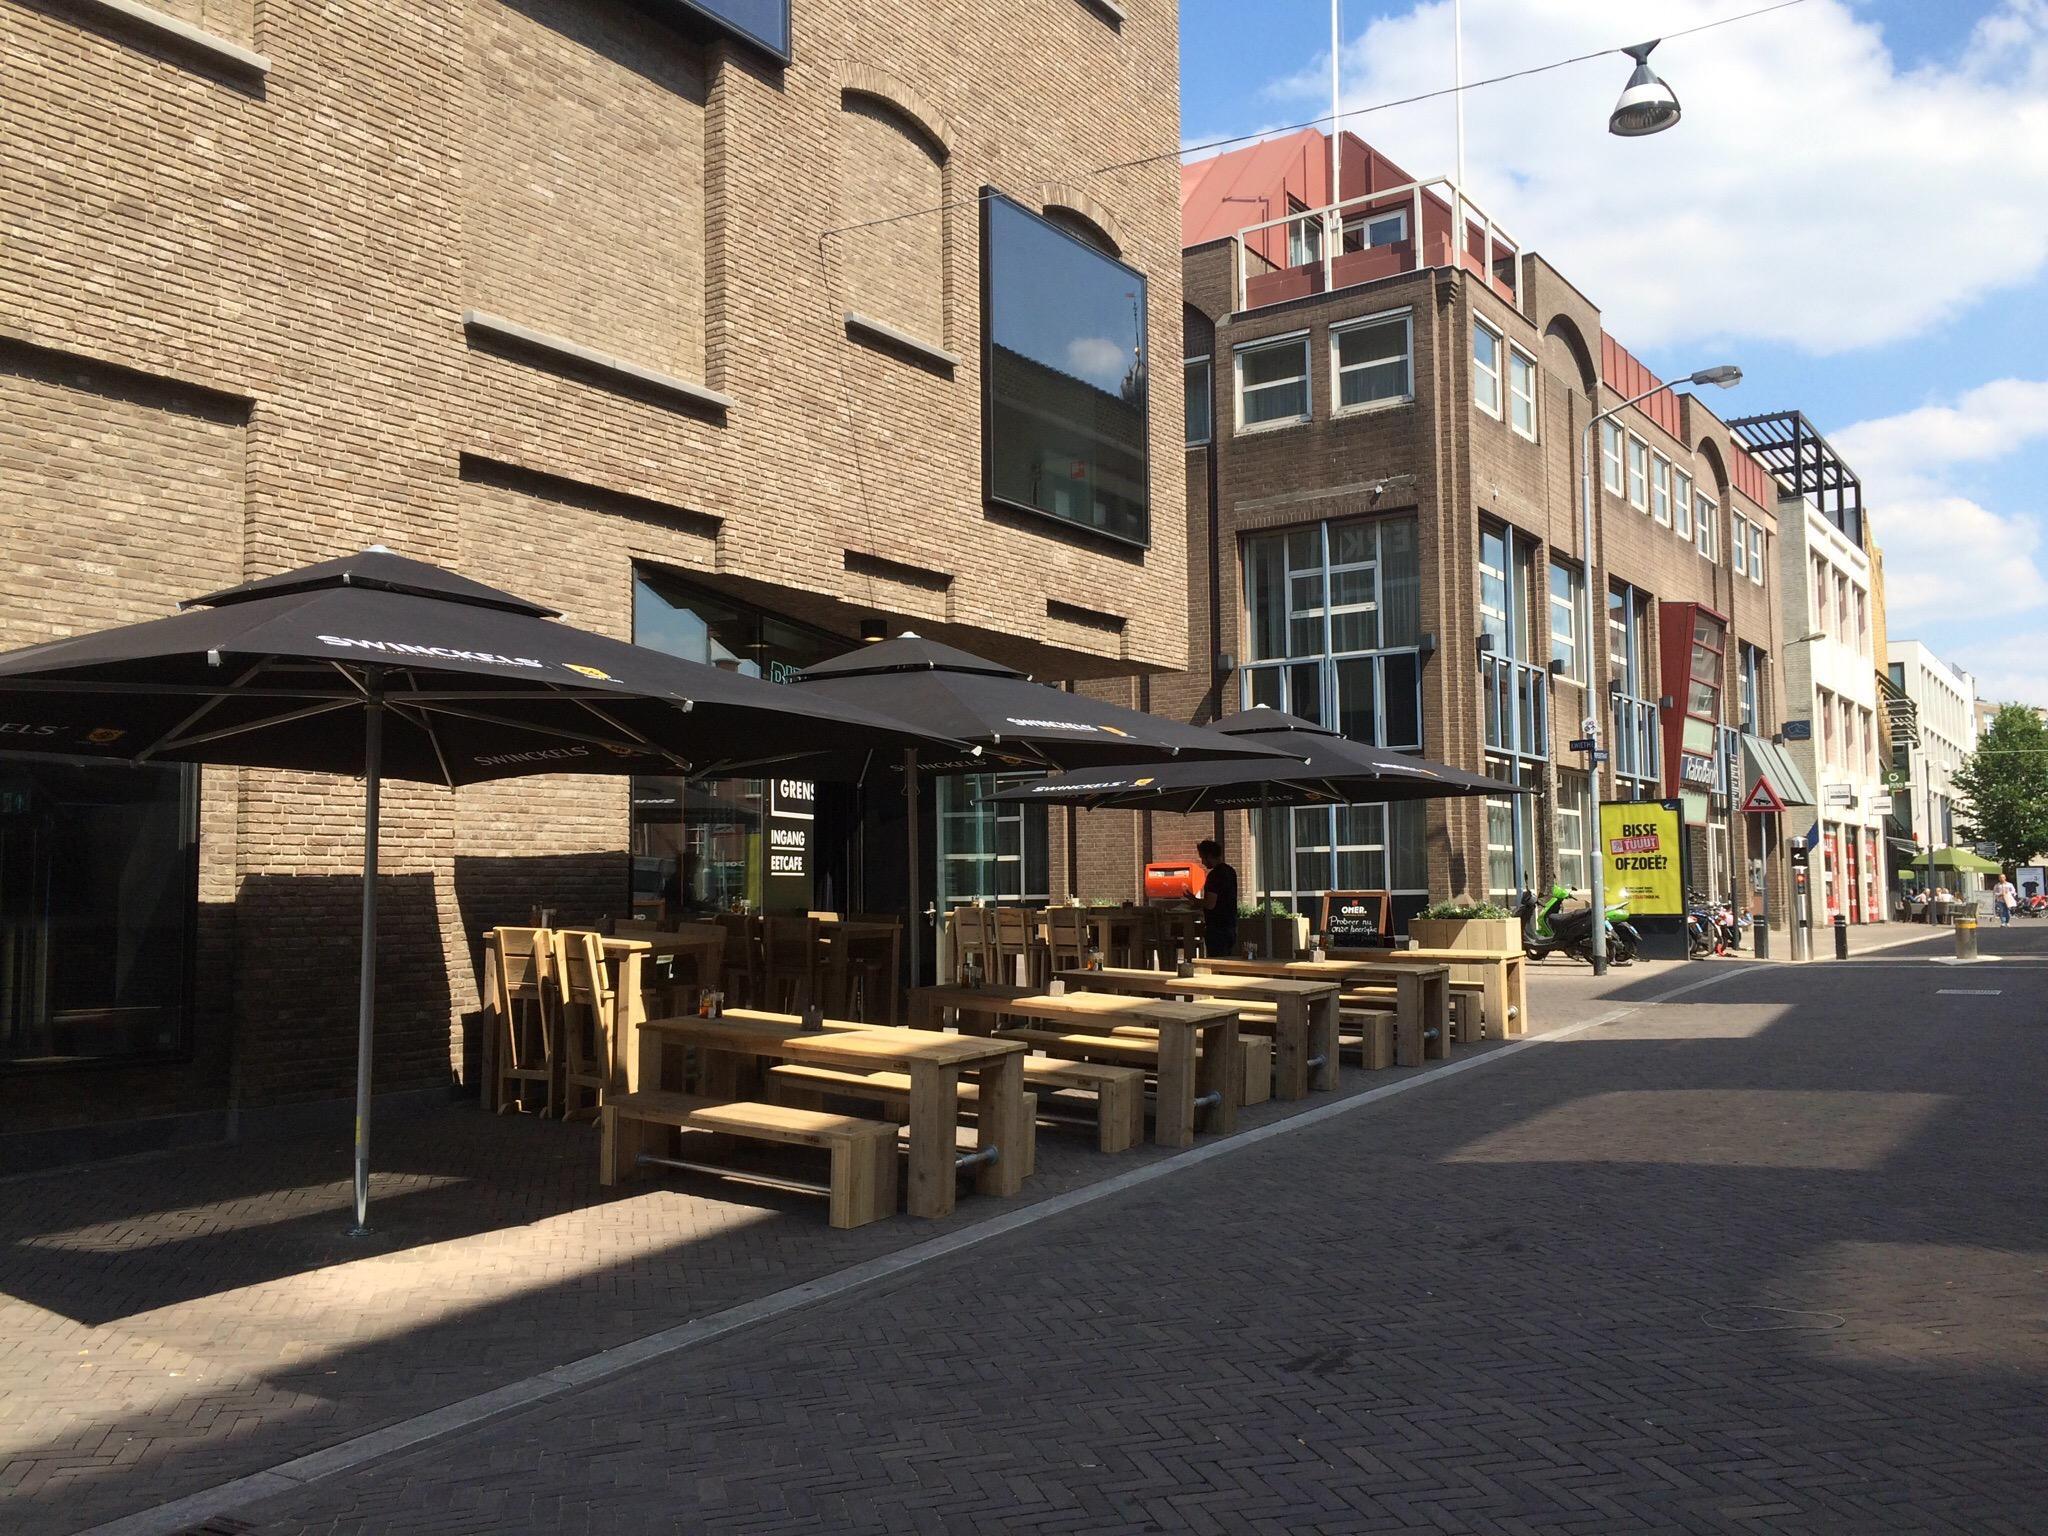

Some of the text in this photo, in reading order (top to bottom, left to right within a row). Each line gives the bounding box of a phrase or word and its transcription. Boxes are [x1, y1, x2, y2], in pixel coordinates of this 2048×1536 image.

[1623, 824, 1657, 837] BISSE
[771, 829, 805, 847] INGANG
[1623, 837, 1656, 850] TUUUT
[771, 855, 803, 871] EETCAFE
[1615, 855, 1668, 870] OFZOEË?
[1329, 915, 1359, 927] Probeer
[1331, 926, 1349, 934] onze
